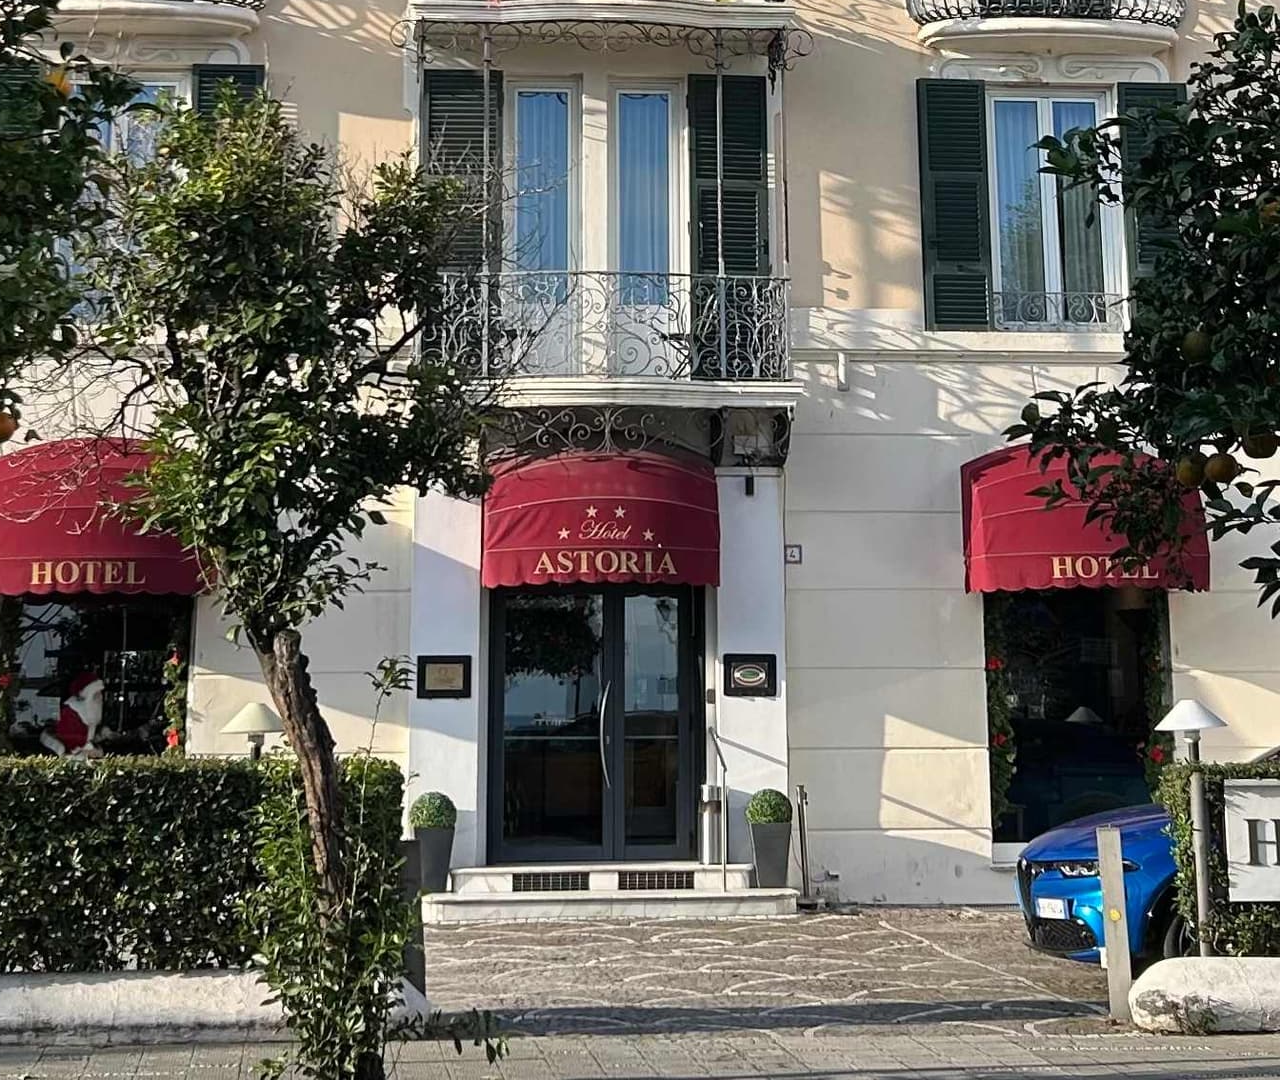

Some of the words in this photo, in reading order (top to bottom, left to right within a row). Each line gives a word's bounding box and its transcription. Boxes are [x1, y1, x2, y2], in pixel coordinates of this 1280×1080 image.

[578, 520, 631, 540] Hotel
[30, 561, 146, 585] HOTEL
[533, 550, 678, 575] ASTORIA
